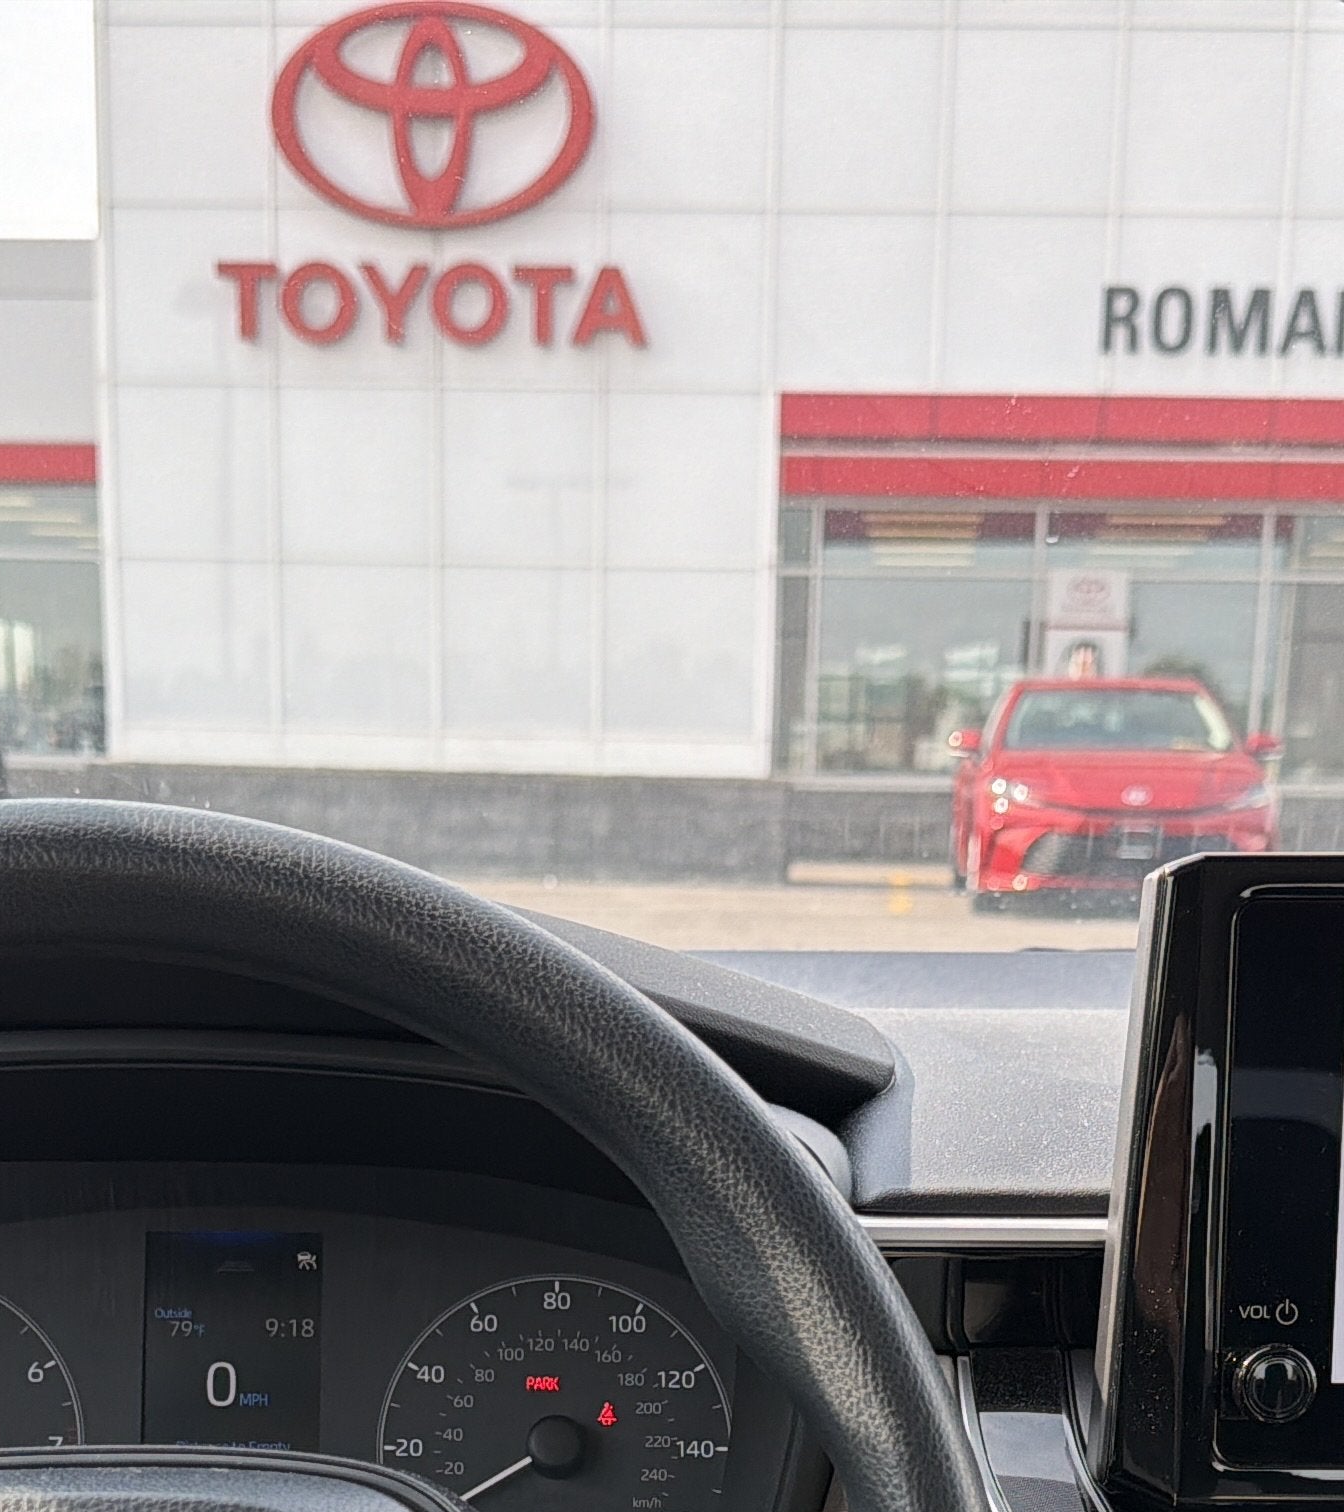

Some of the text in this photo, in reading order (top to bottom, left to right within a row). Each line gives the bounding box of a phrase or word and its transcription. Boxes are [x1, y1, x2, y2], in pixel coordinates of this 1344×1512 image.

[217, 261, 649, 347] TOYOTA
[543, 1292, 571, 1311] 80
[155, 1307, 193, 1319] Outside
[1239, 1305, 1271, 1319] VOL
[265, 1318, 315, 1338] 9:18
[470, 1314, 498, 1333] 60
[609, 1315, 646, 1333] 100
[528, 1338, 555, 1351] 120
[562, 1338, 590, 1352] 140
[497, 1348, 524, 1361] 100
[594, 1350, 622, 1363] 160
[27, 1361, 44, 1383] 6
[417, 1365, 445, 1383] 40
[474, 1369, 495, 1383] 80
[657, 1370, 695, 1388] 120
[207, 1361, 268, 1407] 0 MPH
[526, 1376, 560, 1392] PARK
[617, 1373, 645, 1386] 180
[453, 1395, 474, 1408] 60
[635, 1402, 662, 1415] 200
[443, 1428, 464, 1441] 40
[645, 1435, 671, 1448] 220
[395, 1439, 423, 1457] 20
[676, 1440, 714, 1458] 140
[443, 1462, 464, 1475] 20
[640, 1468, 668, 1482] 240
[632, 1496, 662, 1509] km/h
